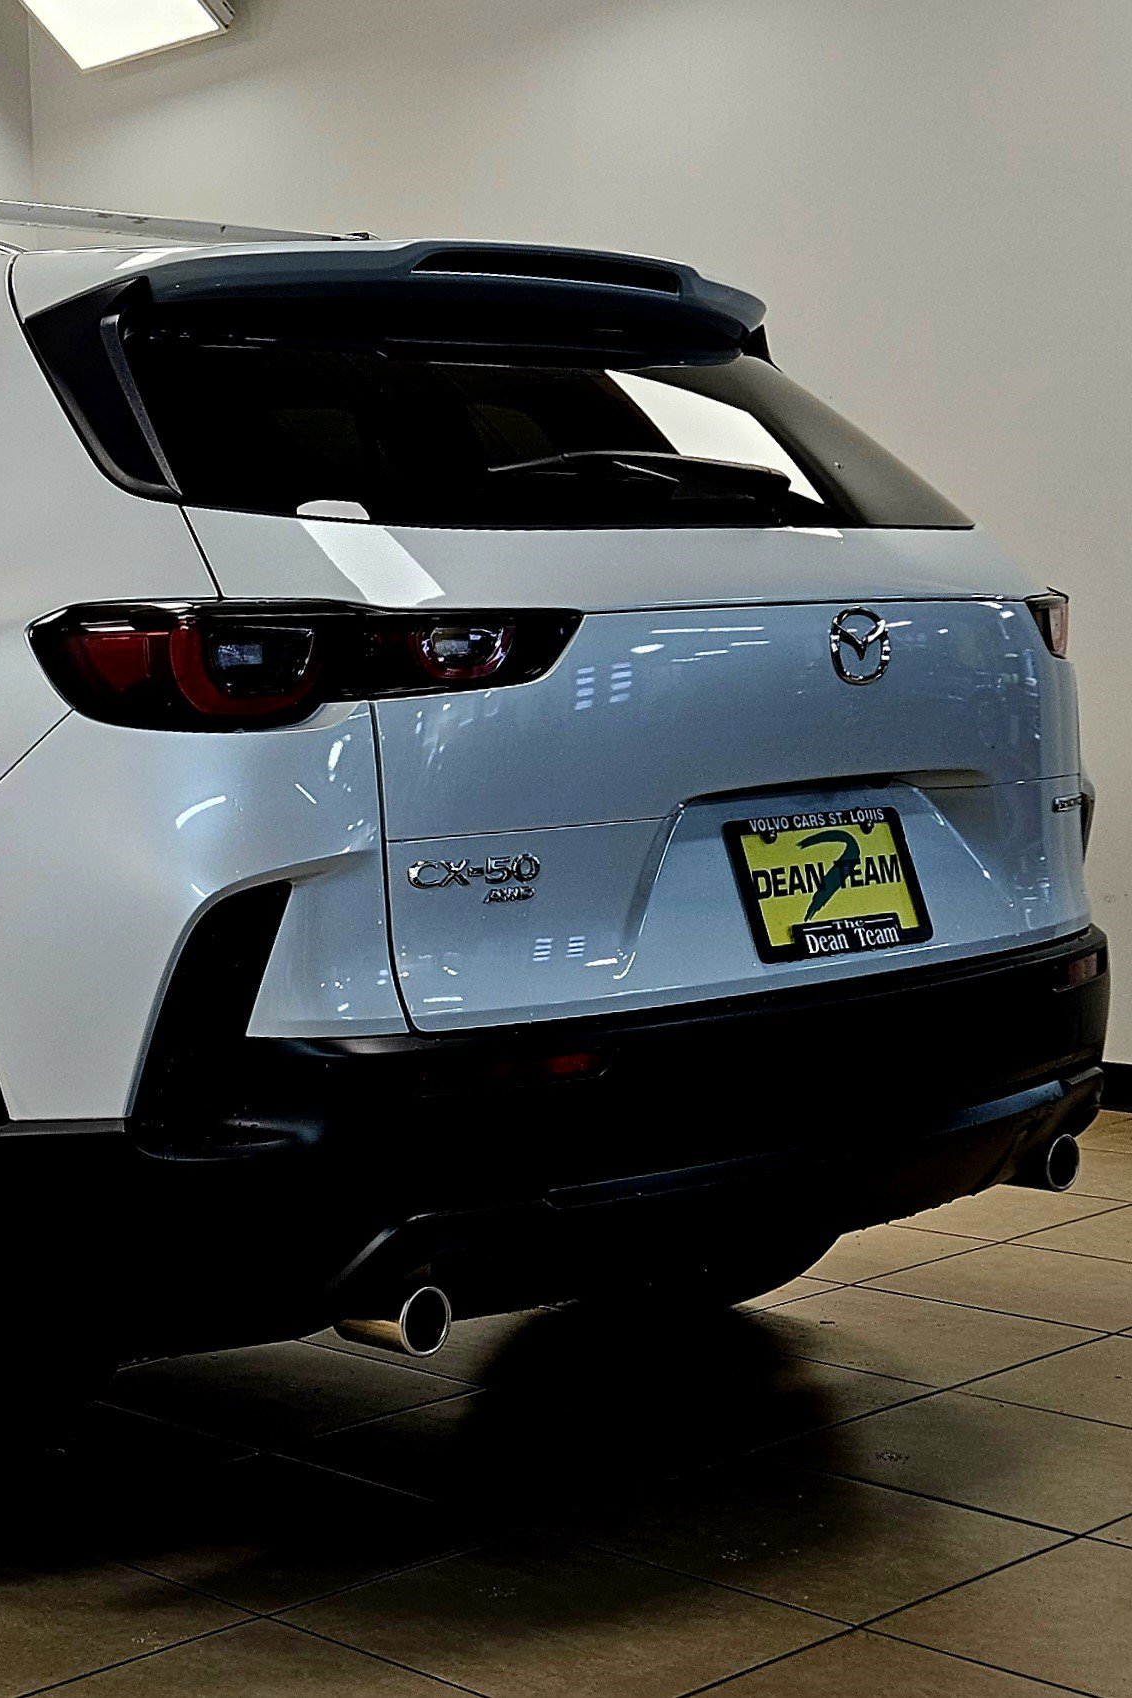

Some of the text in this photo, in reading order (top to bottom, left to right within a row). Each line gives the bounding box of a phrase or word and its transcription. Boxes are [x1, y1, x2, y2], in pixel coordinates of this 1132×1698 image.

[749, 808, 885, 833] VOLVO CARS ST. LOUIS
[407, 852, 541, 890] CX-50
[751, 854, 902, 900] DEAN TEAM
[483, 885, 536, 904] AWD
[832, 918, 866, 931] The
[804, 925, 900, 955] Dean Team
